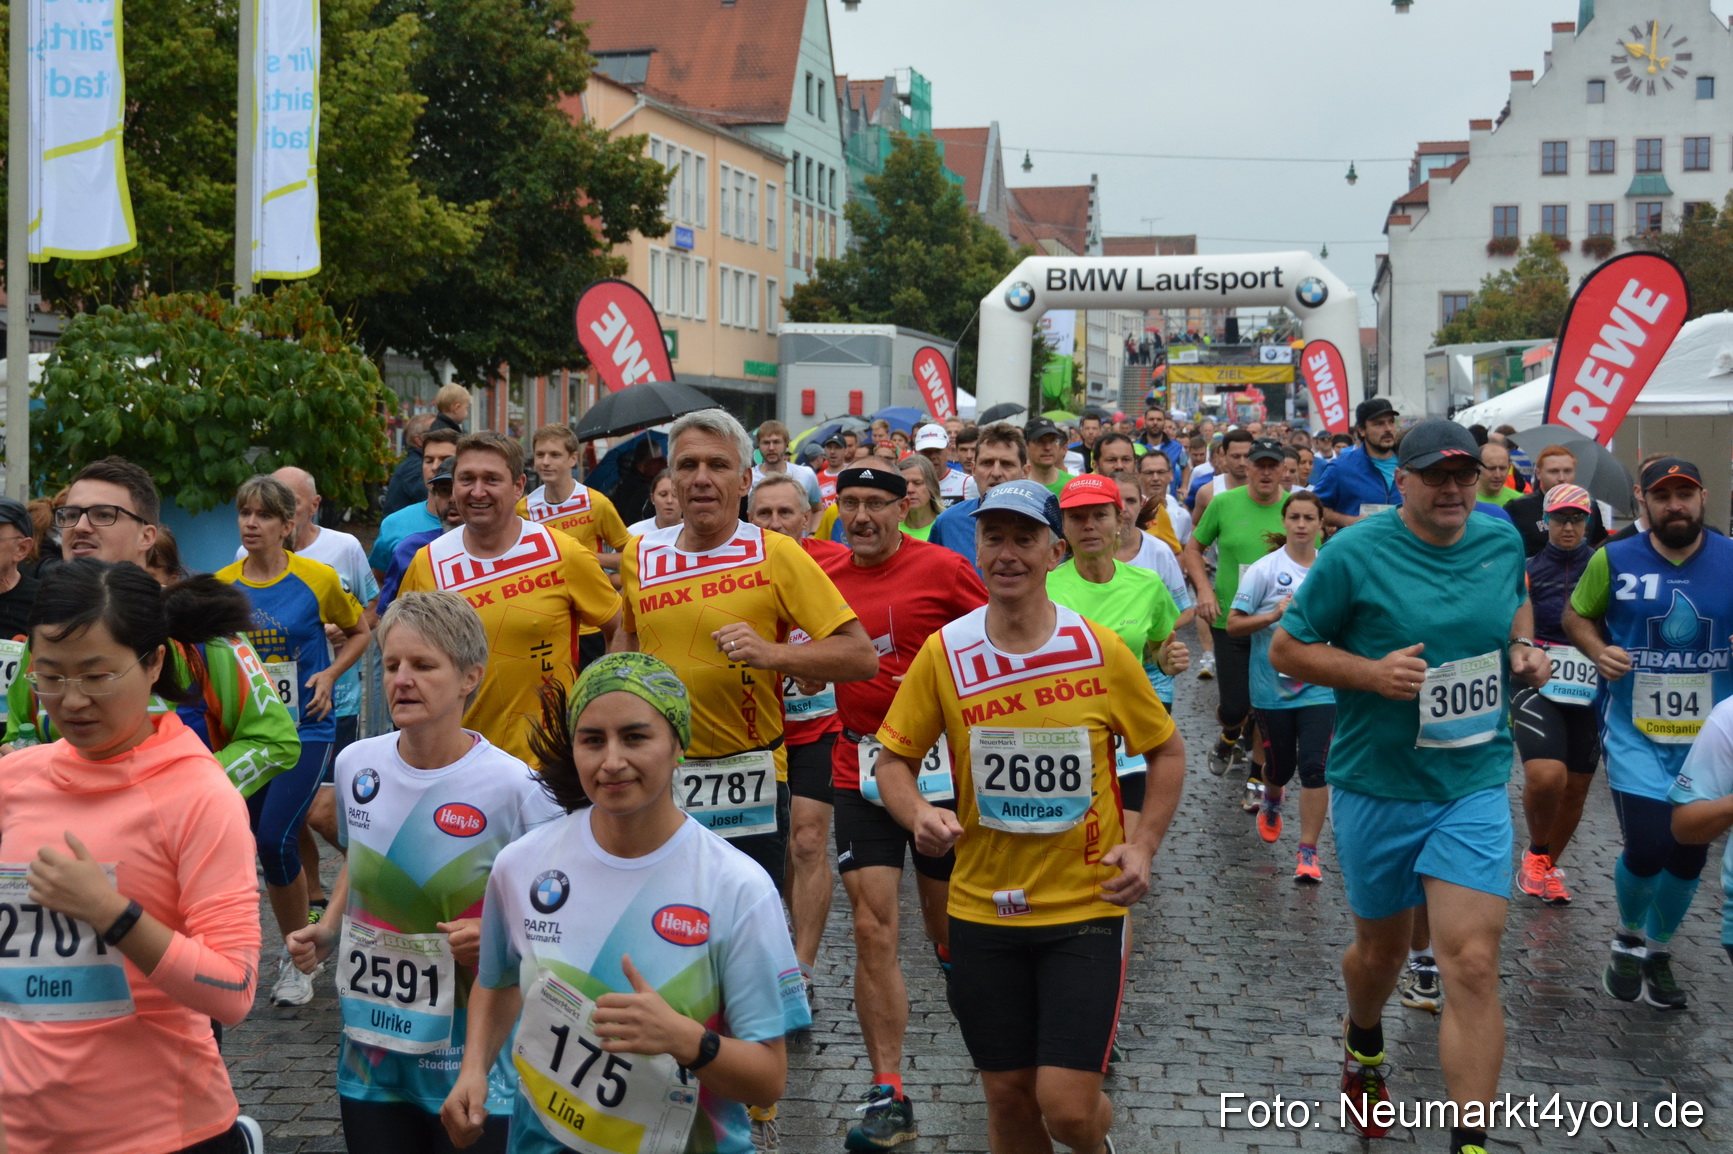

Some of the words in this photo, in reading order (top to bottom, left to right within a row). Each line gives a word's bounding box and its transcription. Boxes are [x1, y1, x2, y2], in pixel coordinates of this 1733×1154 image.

[1046, 268, 1128, 292] BMW
[1137, 266, 1284, 295] Laufsport
[1558, 278, 1669, 439] REWE
[1217, 369, 1245, 380] ZIEL
[991, 487, 1034, 501] QUELLE.
[561, 515, 594, 530] BÖGL
[501, 570, 565, 599] BÖGL
[639, 587, 693, 614] MAX
[701, 570, 770, 598] BÖGL
[1615, 573, 1660, 600] 21
[1461, 655, 1498, 674] BOCK
[1550, 659, 1598, 686] 2092
[1629, 652, 1729, 669] FIBALON
[961, 693, 1027, 727] MAX
[1034, 678, 1107, 707] BÖGL
[1430, 674, 1498, 718] 3066
[1553, 685, 1591, 698] Franziska
[1649, 691, 1700, 717] 194
[786, 701, 812, 713] Josef
[1023, 731, 1080, 744] BOCK
[984, 753, 1081, 793] 2688
[684, 770, 766, 808] 2787
[349, 806, 371, 823] PARTL
[440, 808, 480, 830] Hervis
[709, 812, 743, 828] Josef
[1001, 801, 1063, 818] Andreas
[524, 918, 562, 935] PARTL
[661, 911, 707, 936] Hervis
[383, 933, 442, 953] BOCK
[26, 975, 73, 998] Chen
[350, 949, 439, 1007] 2591
[540, 987, 581, 1020] NeuerMarkt
[371, 1008, 412, 1035] Ulrike
[549, 1023, 633, 1108] 175
[547, 1091, 585, 1131] Lina
